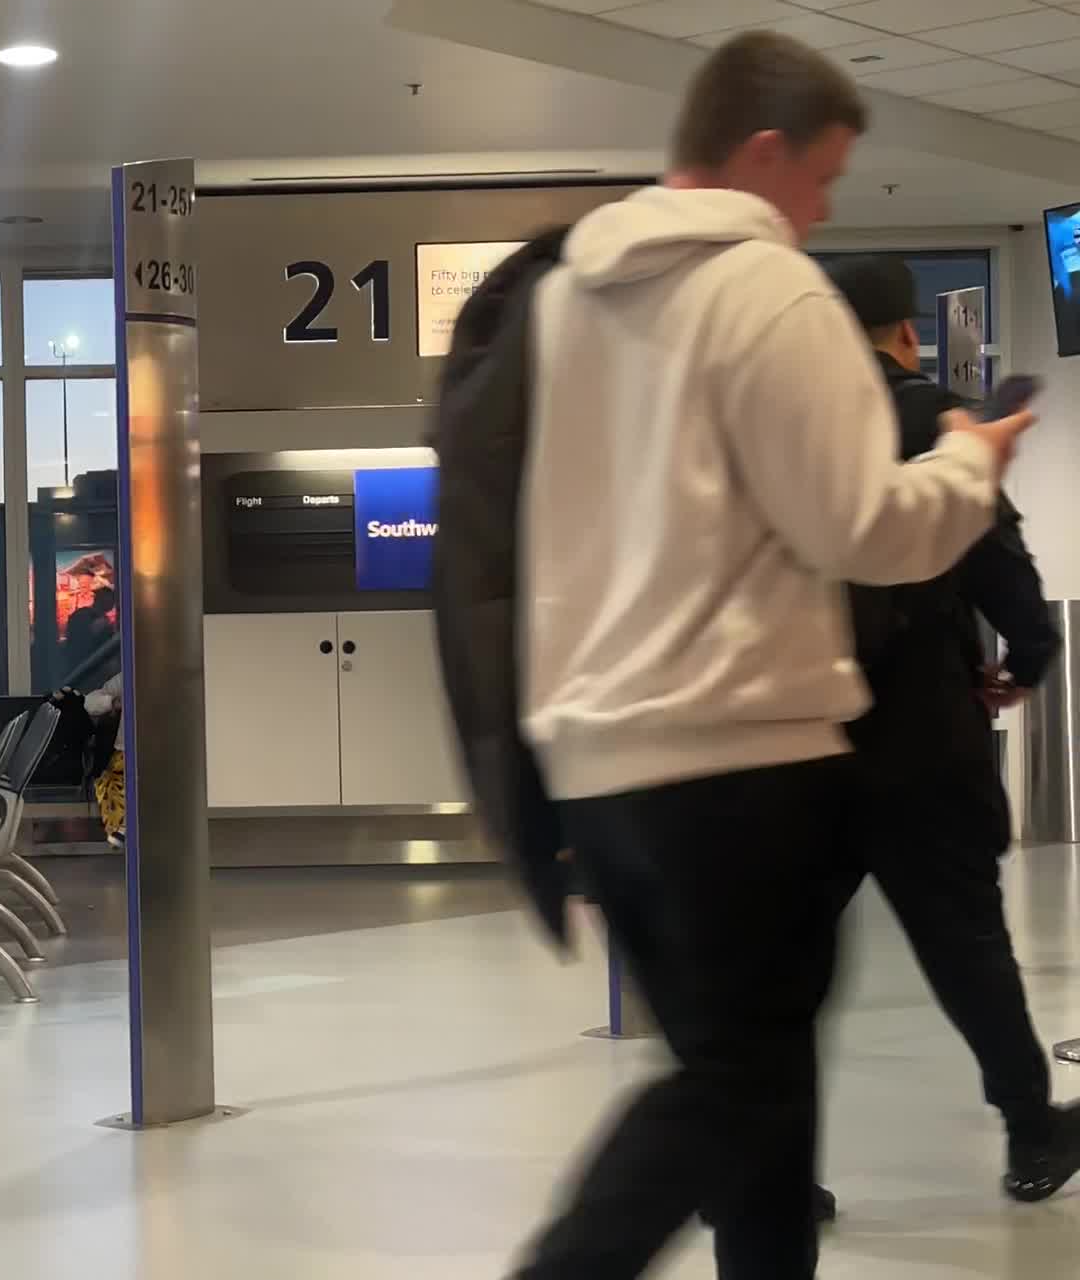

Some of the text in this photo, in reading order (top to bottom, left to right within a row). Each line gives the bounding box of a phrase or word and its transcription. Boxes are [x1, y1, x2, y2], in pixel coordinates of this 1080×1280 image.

[131, 181, 187, 216] 21-25
[147, 260, 194, 295] 26-30
[431, 270, 457, 281] Fifty
[431, 286, 443, 296] to
[284, 260, 389, 343] 21
[236, 495, 340, 507] Flight Departs
[367, 519, 439, 538] Southw
